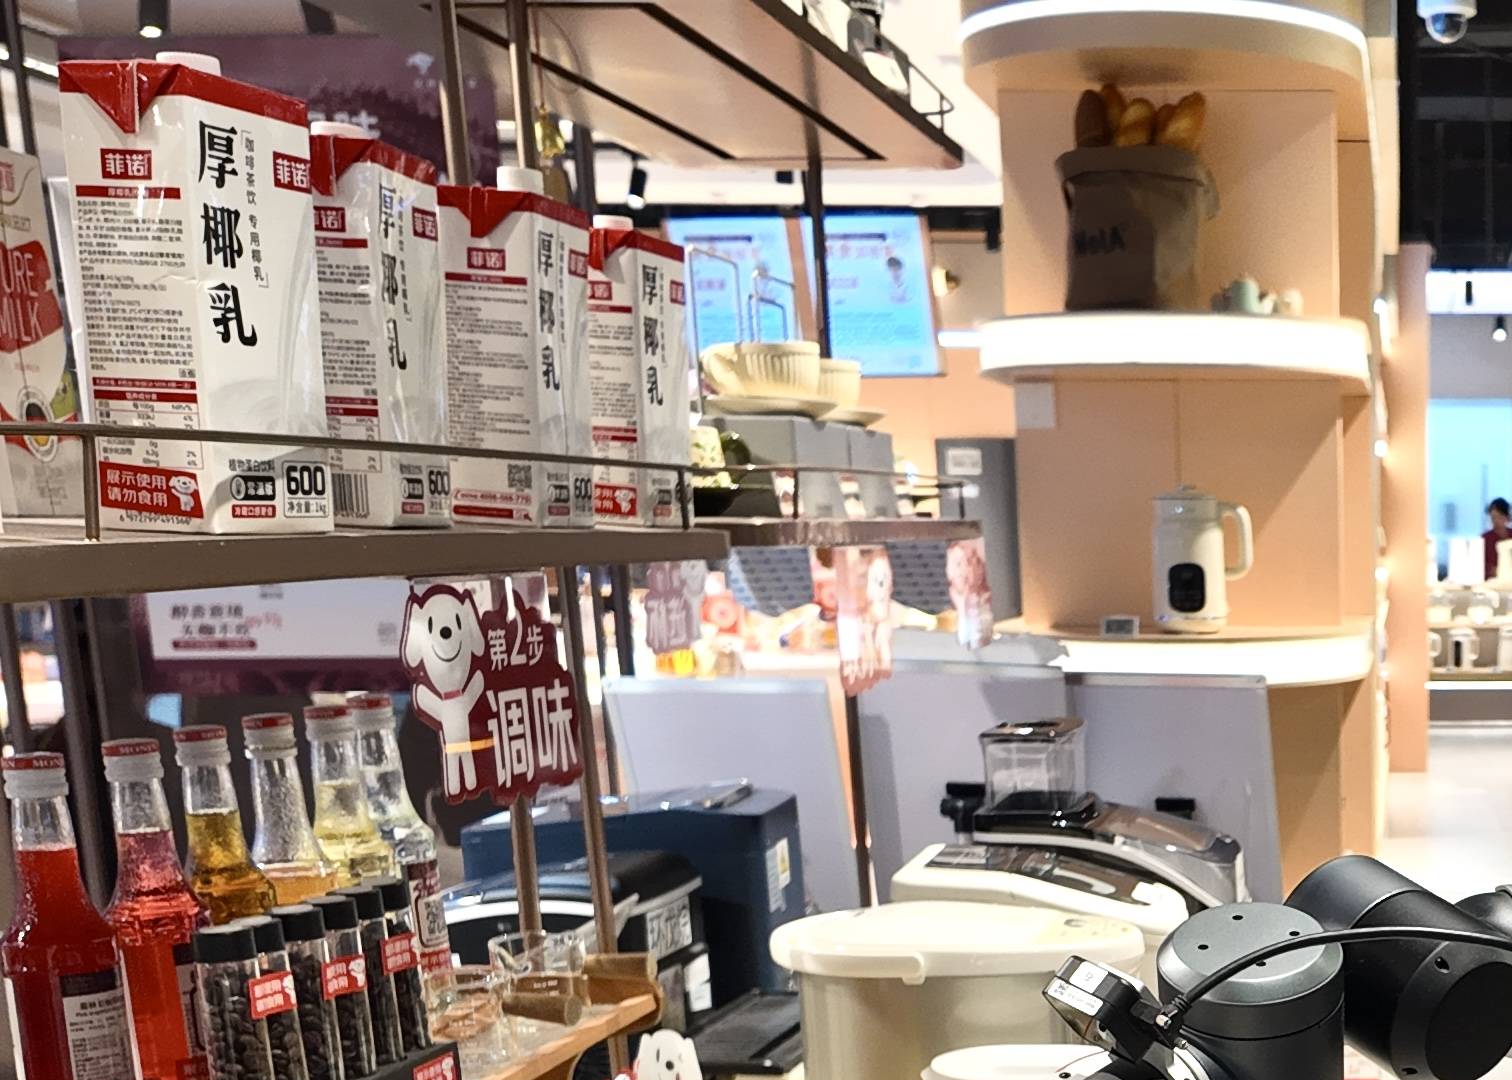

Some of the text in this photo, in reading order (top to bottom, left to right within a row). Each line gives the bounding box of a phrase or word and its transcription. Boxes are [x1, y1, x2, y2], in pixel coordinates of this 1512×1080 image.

[104, 153, 149, 176] 菲诺
[275, 158, 309, 188] 菲诺
[199, 120, 257, 346] 厚椰乳
[107, 469, 167, 491] 展示使用
[286, 466, 326, 496] 600
[428, 470, 449, 496] 600
[574, 478, 592, 500] 600
[107, 486, 168, 508] 请勿食用
[487, 606, 544, 671] 第2步
[486, 678, 578, 788] 调味
